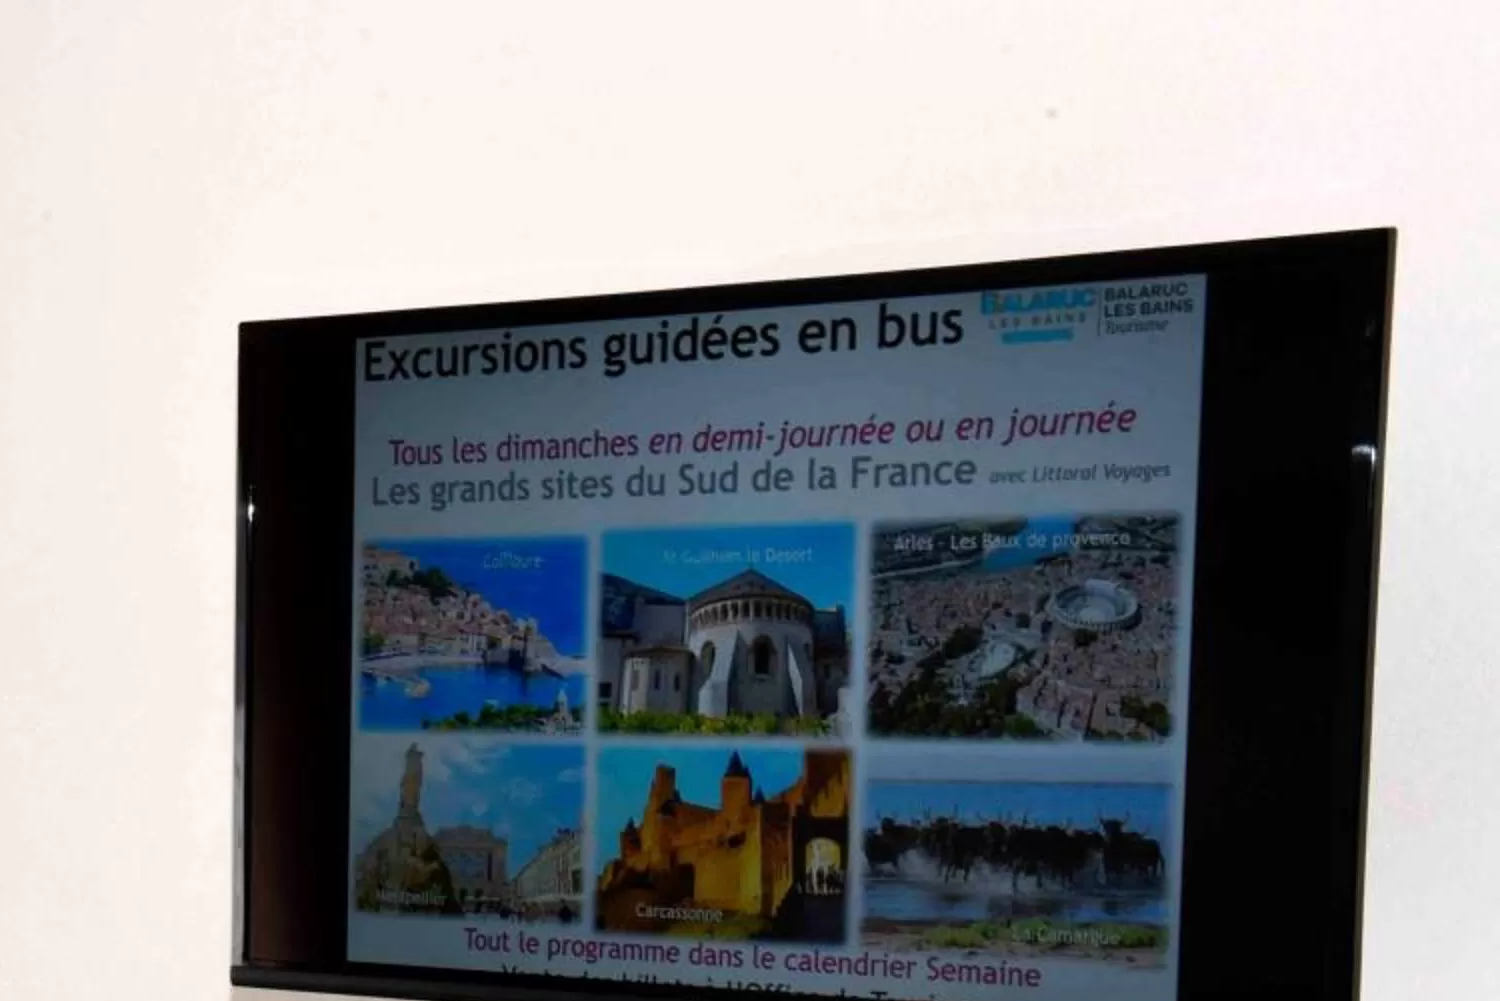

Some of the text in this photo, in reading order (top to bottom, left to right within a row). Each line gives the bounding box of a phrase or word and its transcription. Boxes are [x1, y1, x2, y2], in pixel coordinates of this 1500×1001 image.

[1104, 281, 1189, 302] BALARUC
[1104, 297, 1194, 318] LES BAINS
[363, 303, 965, 381] Excursions guidées en bus
[388, 401, 1137, 467] Tous les dimanches en demi-journée ou en journée
[372, 456, 1172, 512] Les grands sites du Sud de la France avec Littoral Voyages
[950, 534, 978, 550] Les
[1026, 531, 1048, 548] de
[635, 902, 724, 924] Carcassonne
[464, 927, 510, 954] Tout
[519, 930, 540, 956] le
[548, 935, 681, 967] programme
[688, 941, 744, 969] dans
[752, 944, 776, 970] le
[783, 946, 918, 980] calendrier
[927, 955, 1043, 989] Semaine
